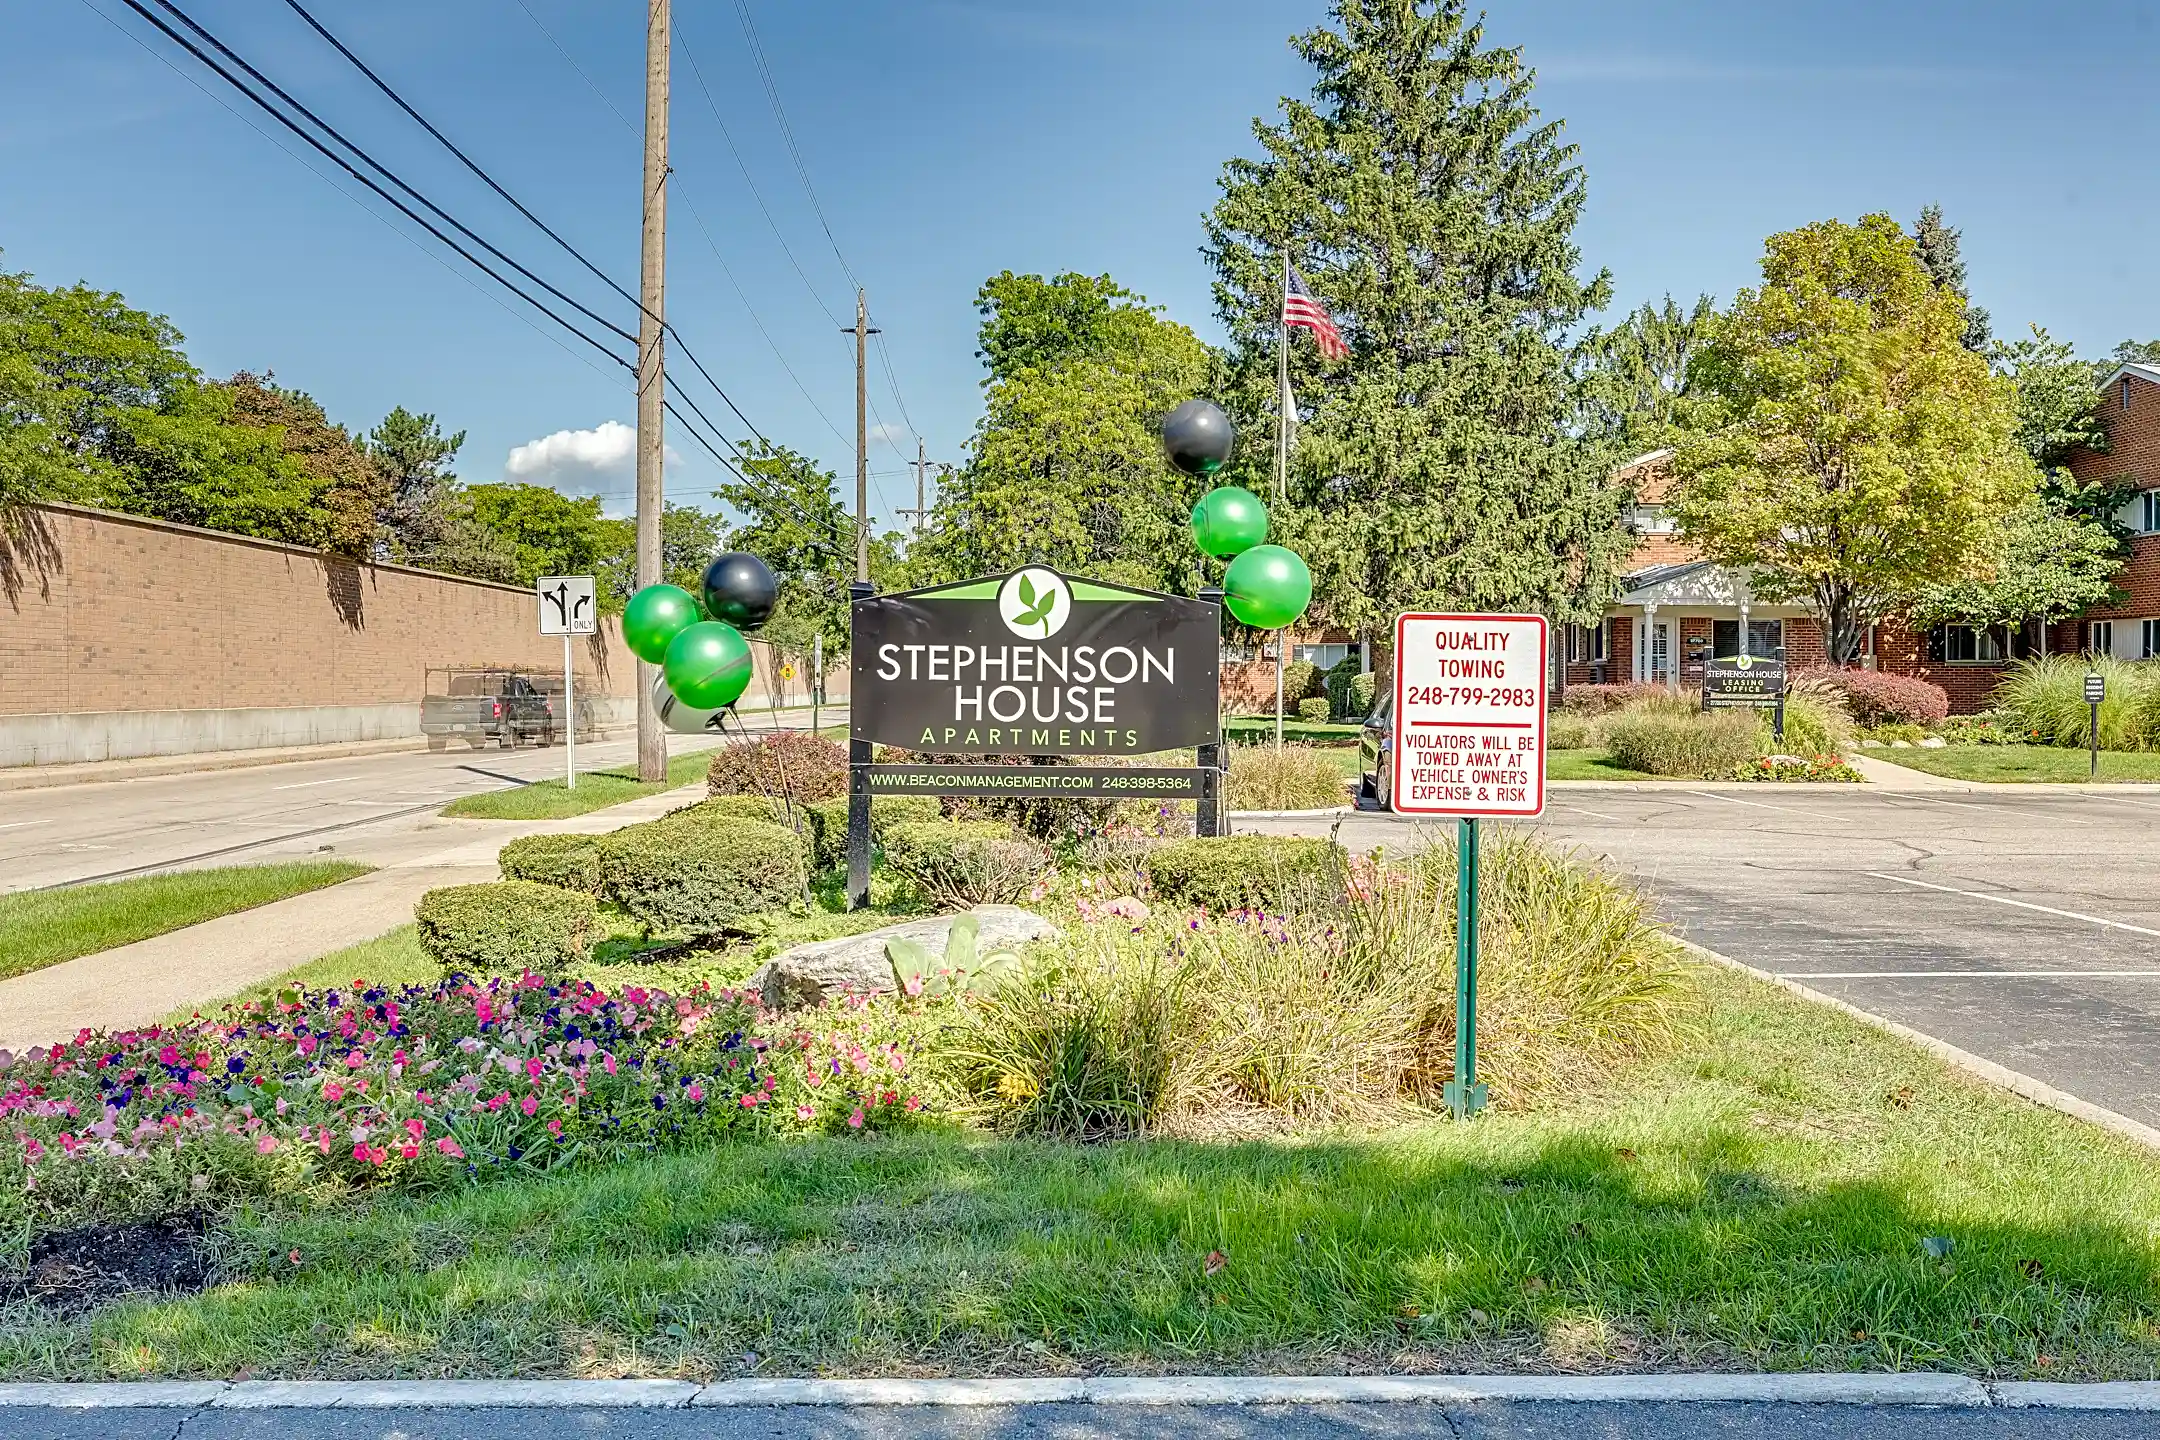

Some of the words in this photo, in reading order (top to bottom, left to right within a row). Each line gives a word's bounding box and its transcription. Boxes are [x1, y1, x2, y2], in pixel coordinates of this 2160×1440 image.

[574, 620, 592, 629] ONLY
[1435, 631, 1510, 651] QUALITY
[876, 643, 1175, 685] STEPHENSON
[1438, 659, 1505, 679] TOWING
[1706, 670, 1755, 678] STEPHENSON
[1755, 671, 1782, 679] HOUSE
[954, 685, 1115, 724] HOUSE
[1408, 686, 1535, 707] 248-799-2983
[920, 727, 1138, 747] APARTMENTS
[1405, 734, 1476, 749] VIOLATORS
[1482, 735, 1511, 750] WILL
[1518, 736, 1535, 751] BE
[1417, 752, 1459, 766] TOWED
[1466, 753, 1501, 767] AWAY
[1508, 753, 1523, 768] AT
[869, 773, 1093, 789] WWW.BEACONMANAGEMENT.COM
[1102, 775, 1192, 790] 248-398-5364
[1411, 768, 1465, 783] VEHICLE
[1472, 769, 1528, 785] OWNER'S
[1412, 786, 1470, 800] EXPENSE
[1477, 787, 1490, 801] &
[1497, 788, 1526, 802] RISK
